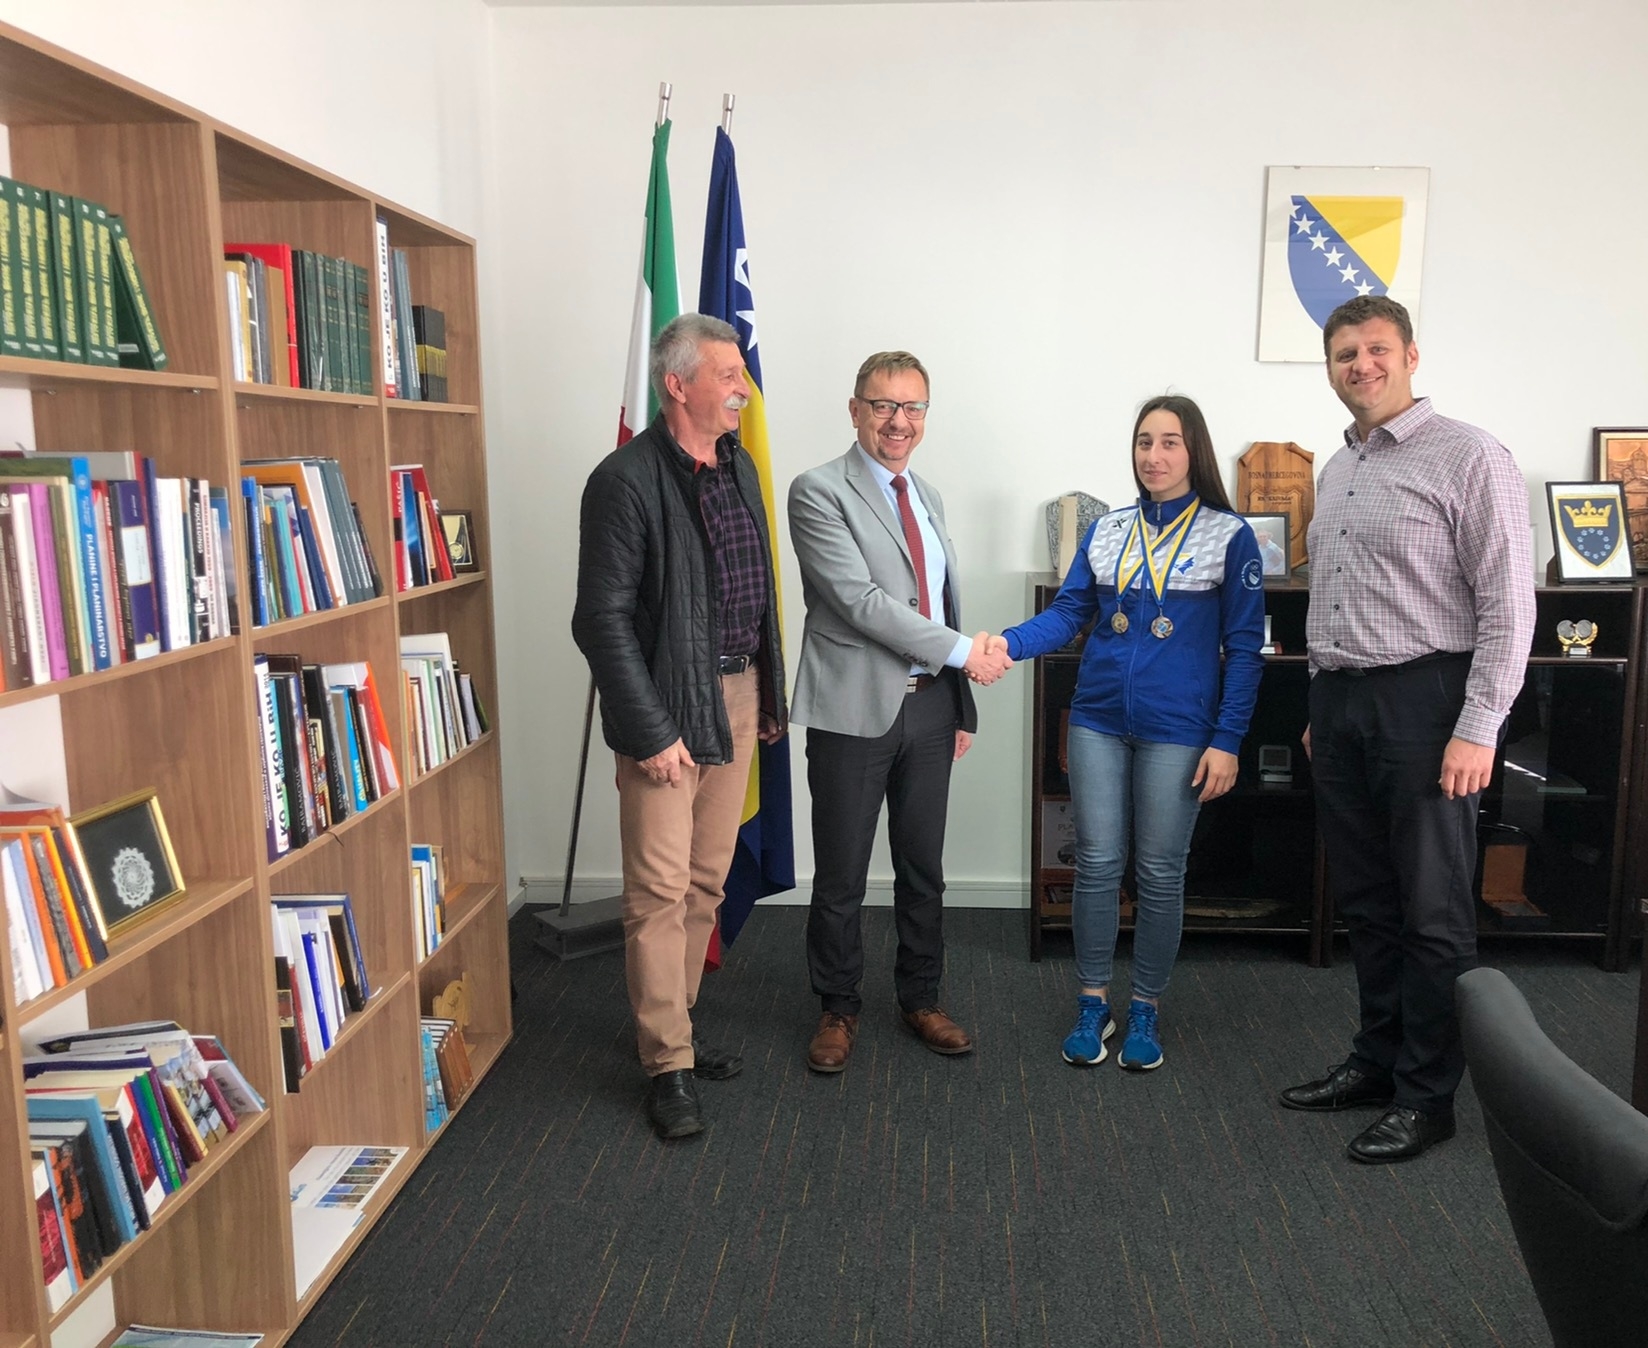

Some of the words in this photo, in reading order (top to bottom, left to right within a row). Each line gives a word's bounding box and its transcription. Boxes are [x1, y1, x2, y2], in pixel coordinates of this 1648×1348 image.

[383, 289, 389, 313] KO
[386, 345, 392, 368] KO
[194, 502, 204, 554] PROCEEDINGS
[86, 533, 98, 576] PLANINE
[92, 582, 107, 658] PLANINARSTVO
[279, 809, 289, 837] KO
